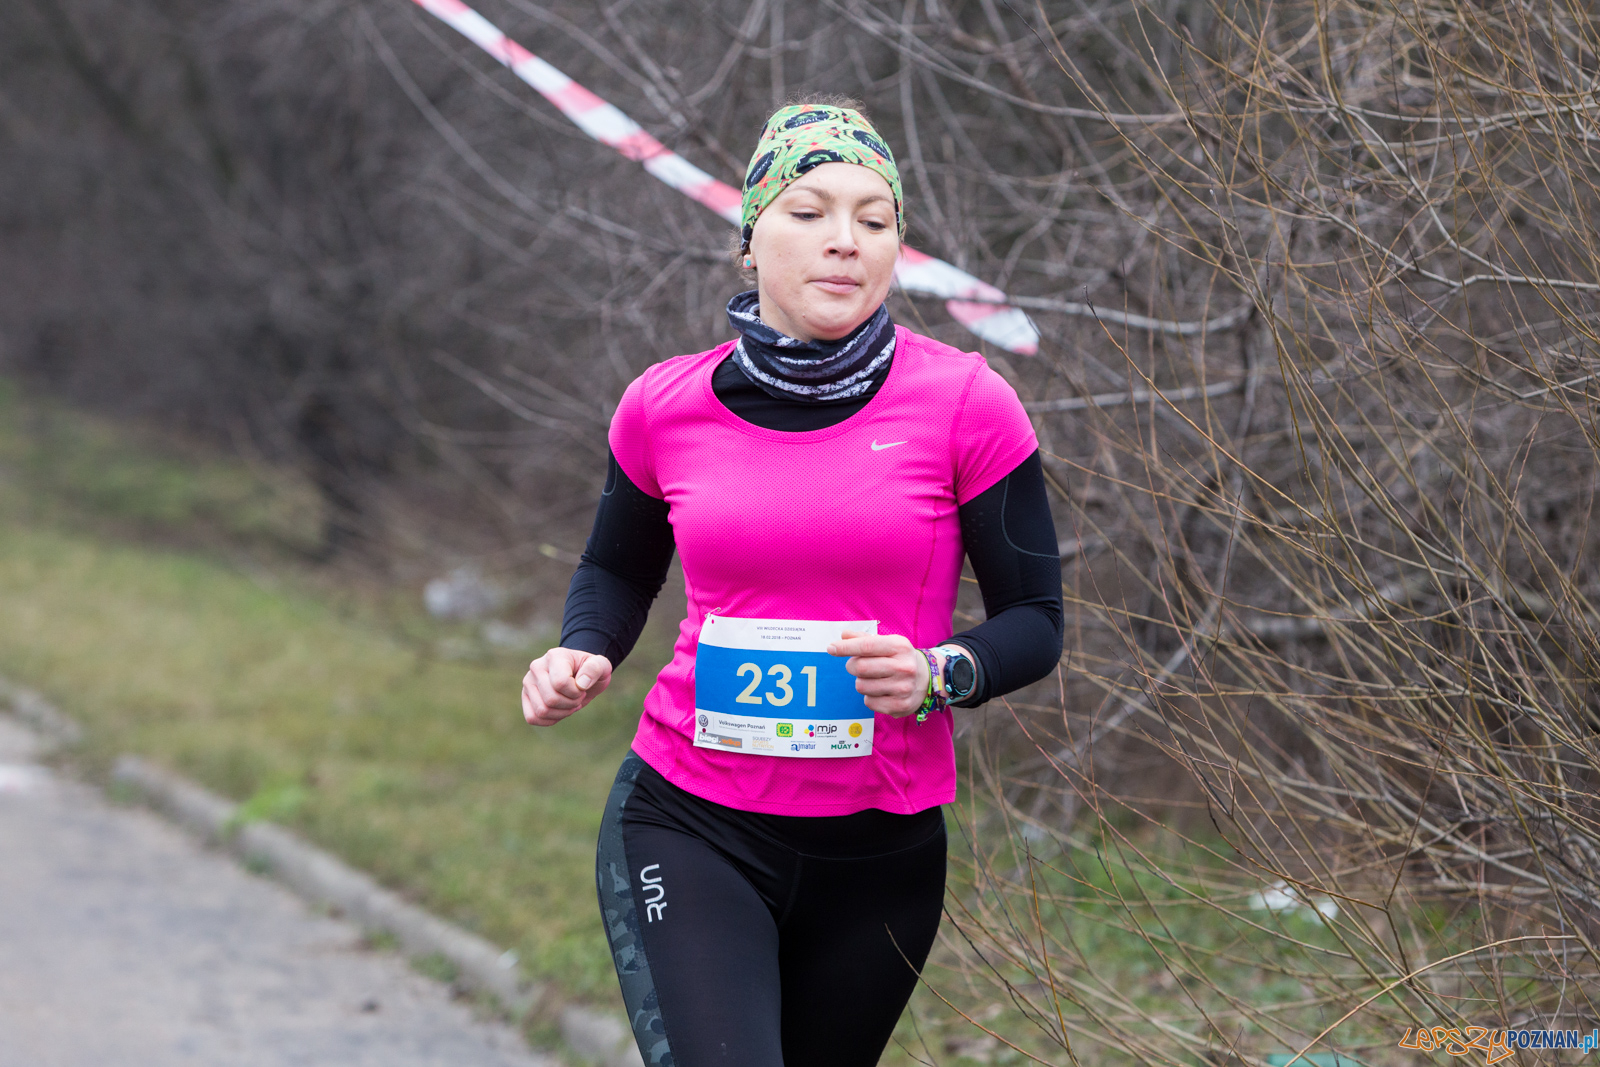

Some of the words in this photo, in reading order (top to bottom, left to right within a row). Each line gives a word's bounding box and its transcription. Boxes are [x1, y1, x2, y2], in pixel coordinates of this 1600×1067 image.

[735, 662, 817, 707] 231
[718, 719, 747, 729] Volkswagen
[817, 723, 838, 734] mjp
[640, 863, 668, 923] RUN
